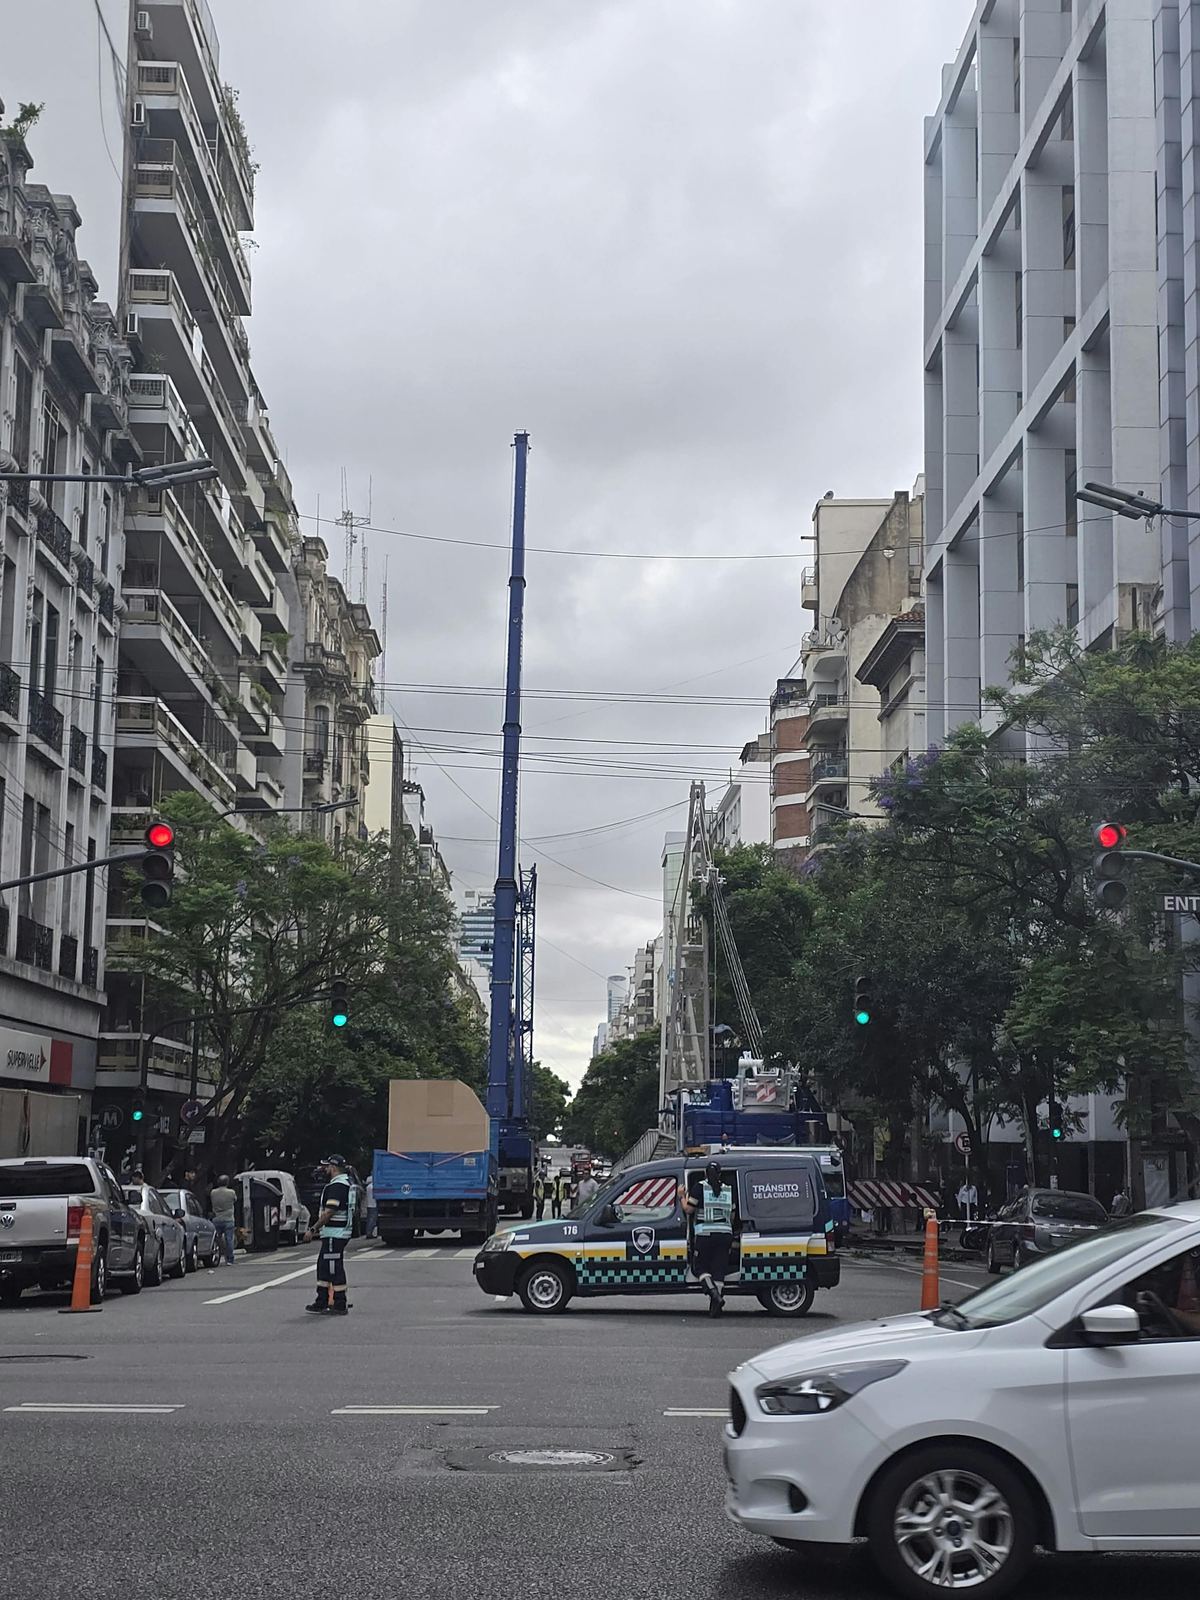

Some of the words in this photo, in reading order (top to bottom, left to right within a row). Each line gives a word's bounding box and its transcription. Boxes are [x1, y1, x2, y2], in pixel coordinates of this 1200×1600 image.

[1164, 896, 1200, 911] ENT
[752, 1183, 799, 1193] TRÁNSITO
[773, 1191, 800, 1199] CIUDAD
[563, 1225, 578, 1235] 176
